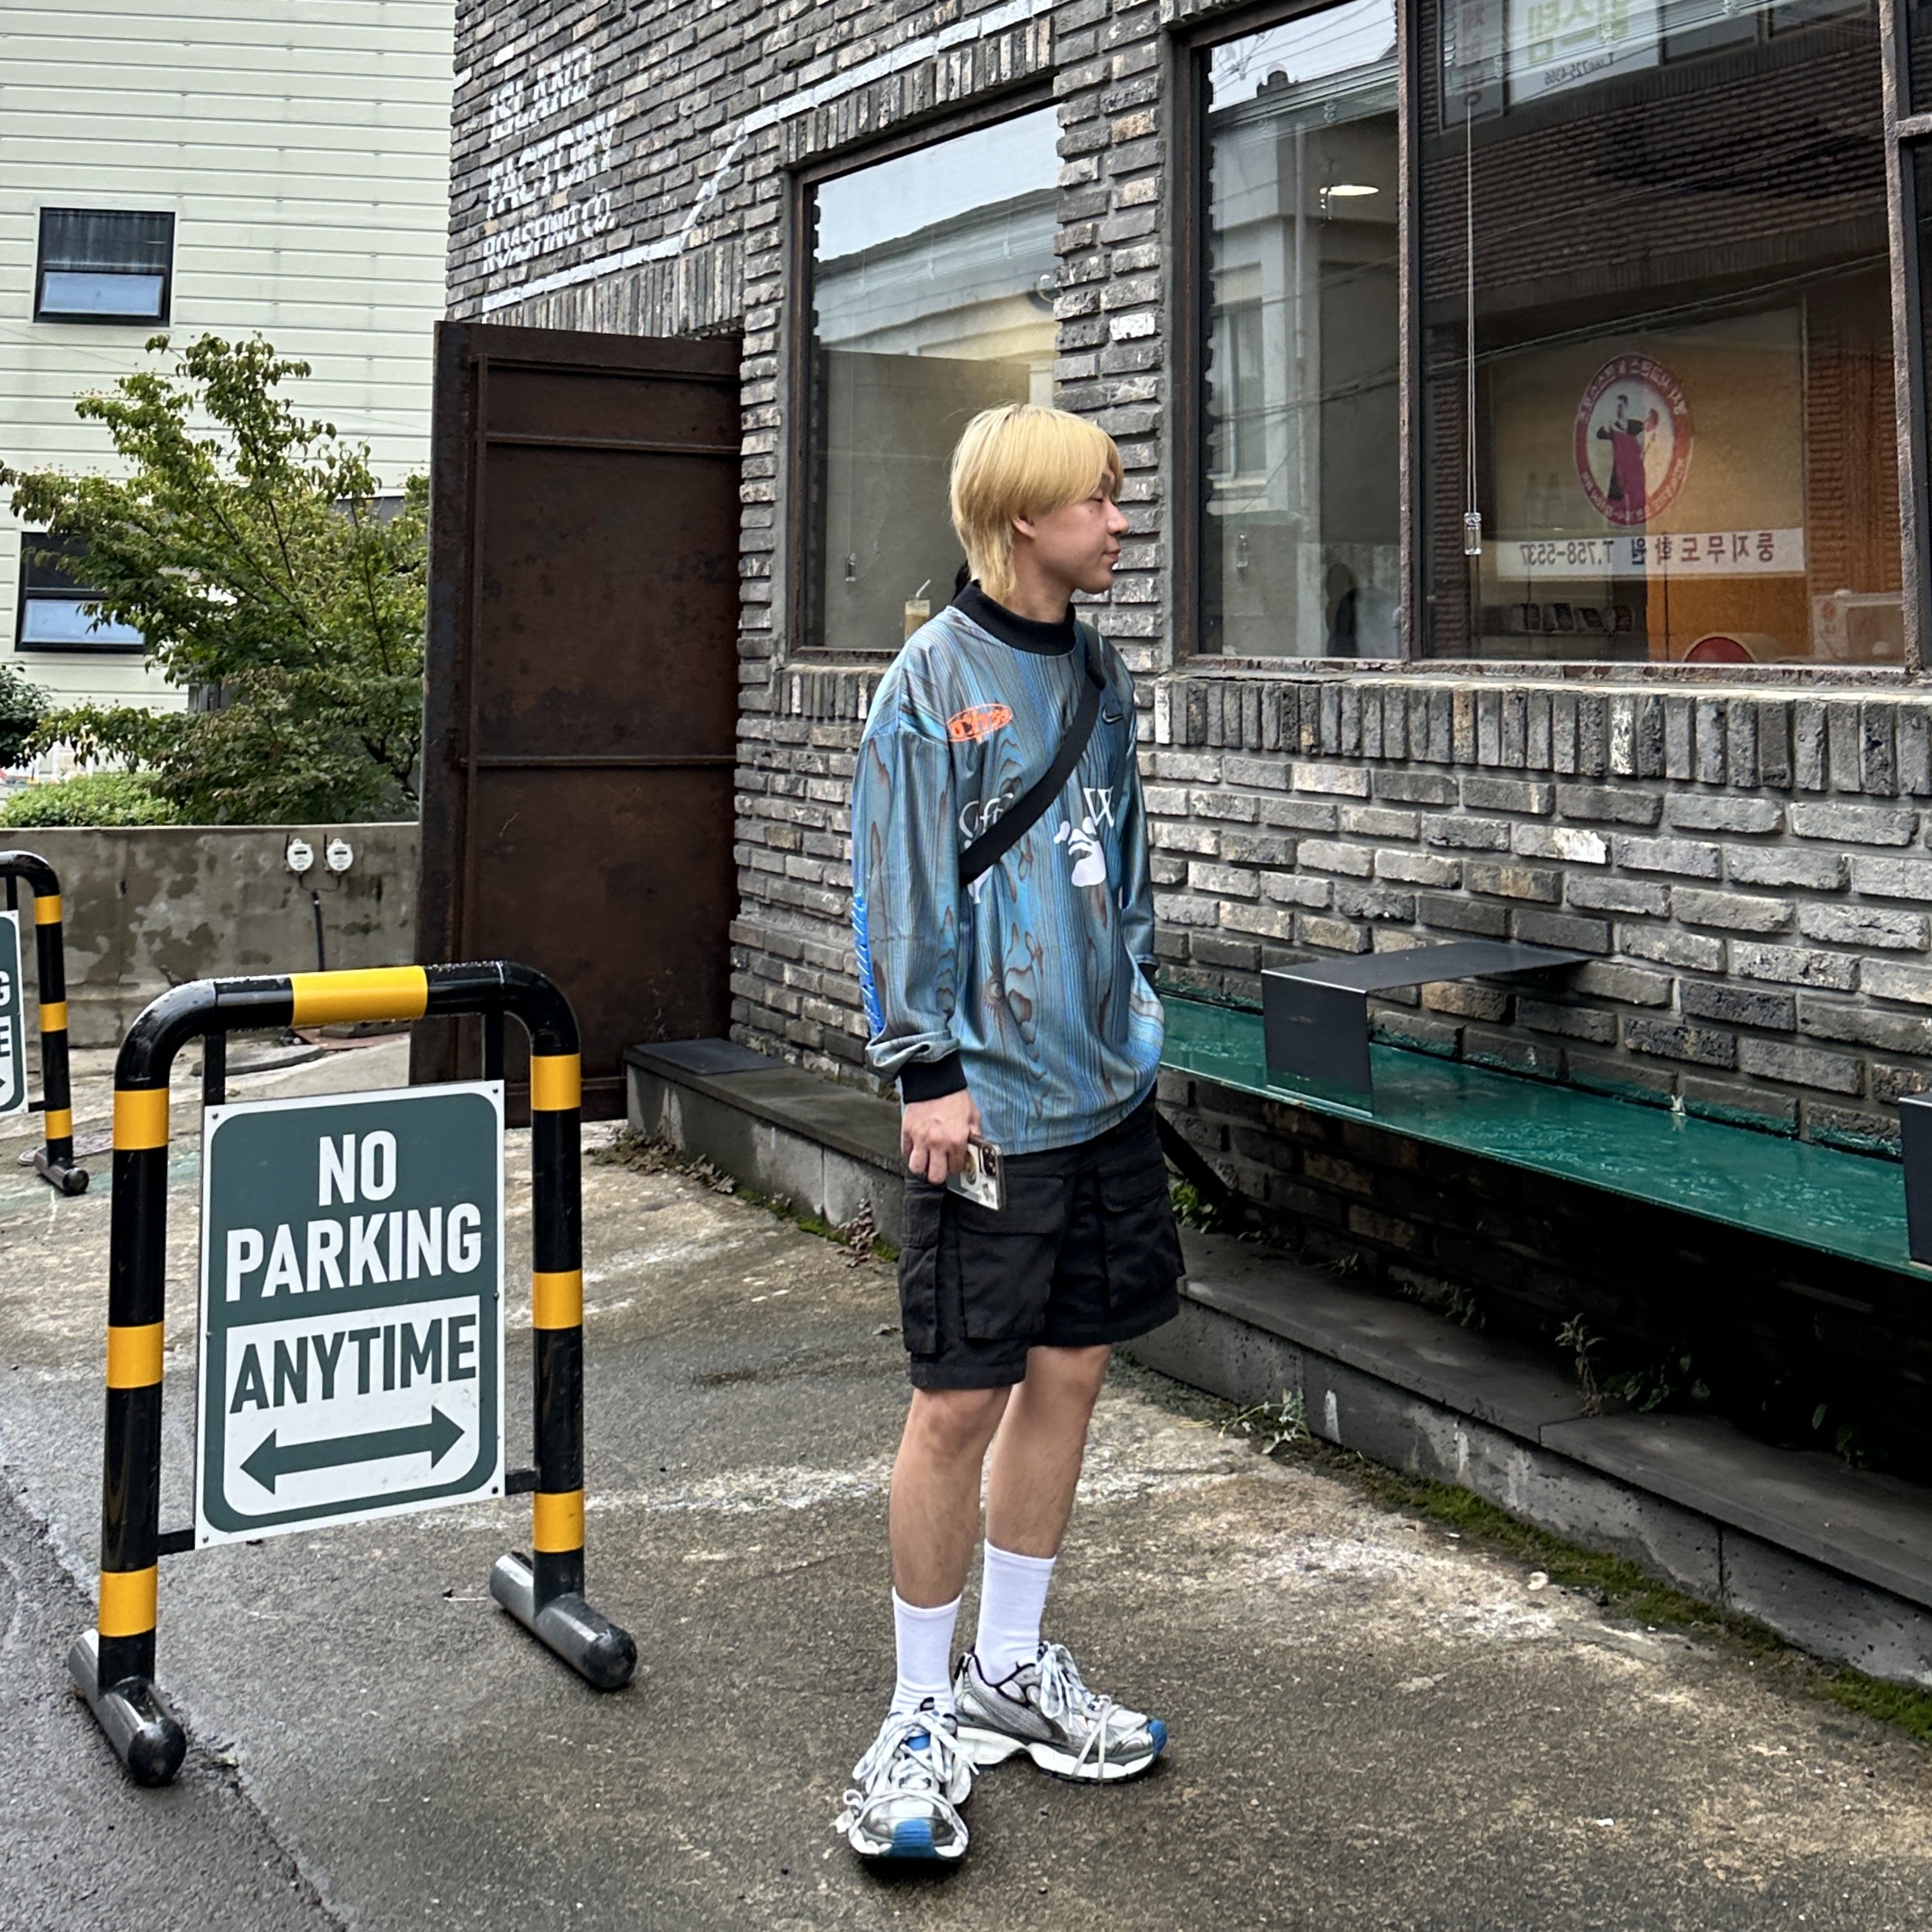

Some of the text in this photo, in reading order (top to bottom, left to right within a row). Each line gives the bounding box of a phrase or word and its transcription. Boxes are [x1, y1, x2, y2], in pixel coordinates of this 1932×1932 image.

[486, 107, 617, 219] FACTORY
[482, 203, 580, 274] ROASTING
[318, 1130, 397, 1206] NO
[226, 1202, 482, 1302] PARKING
[229, 1313, 477, 1414] ANYTIME
